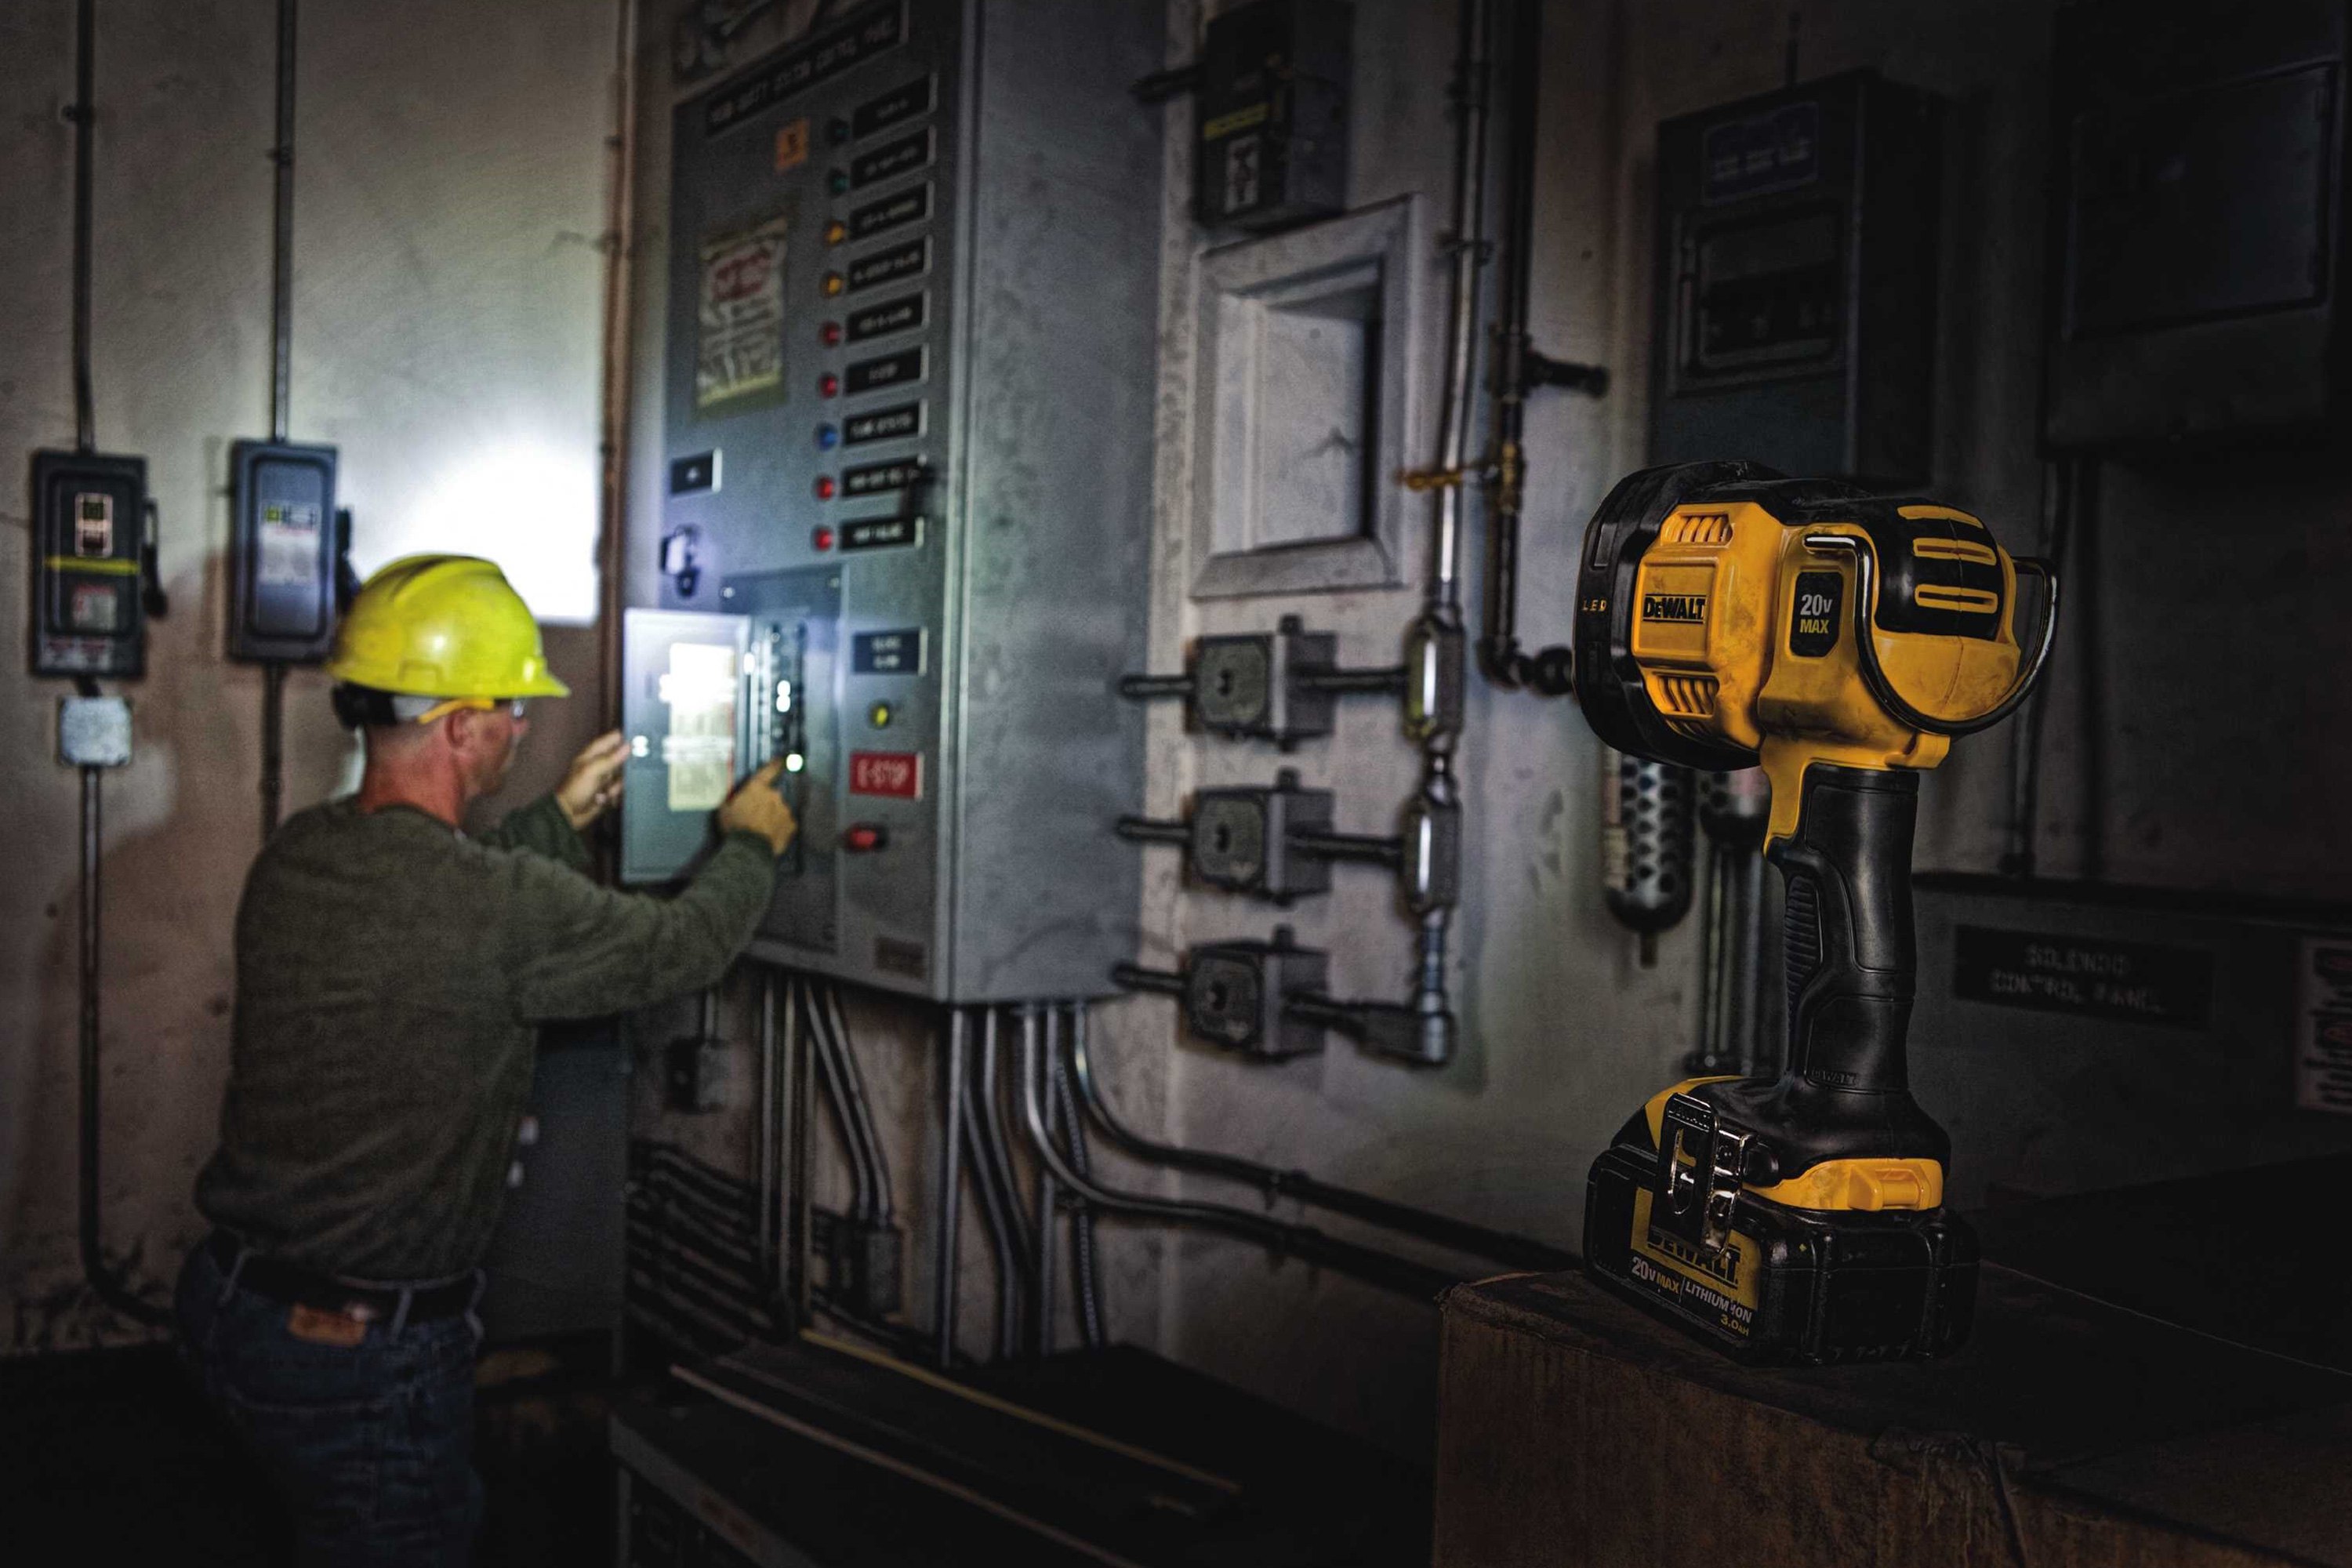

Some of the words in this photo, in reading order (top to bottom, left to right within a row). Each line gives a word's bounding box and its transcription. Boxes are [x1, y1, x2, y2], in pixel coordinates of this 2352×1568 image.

[1582, 597, 1607, 612] LED
[1799, 618, 1830, 634] MAX
[1656, 1271, 1679, 1294] MAX
